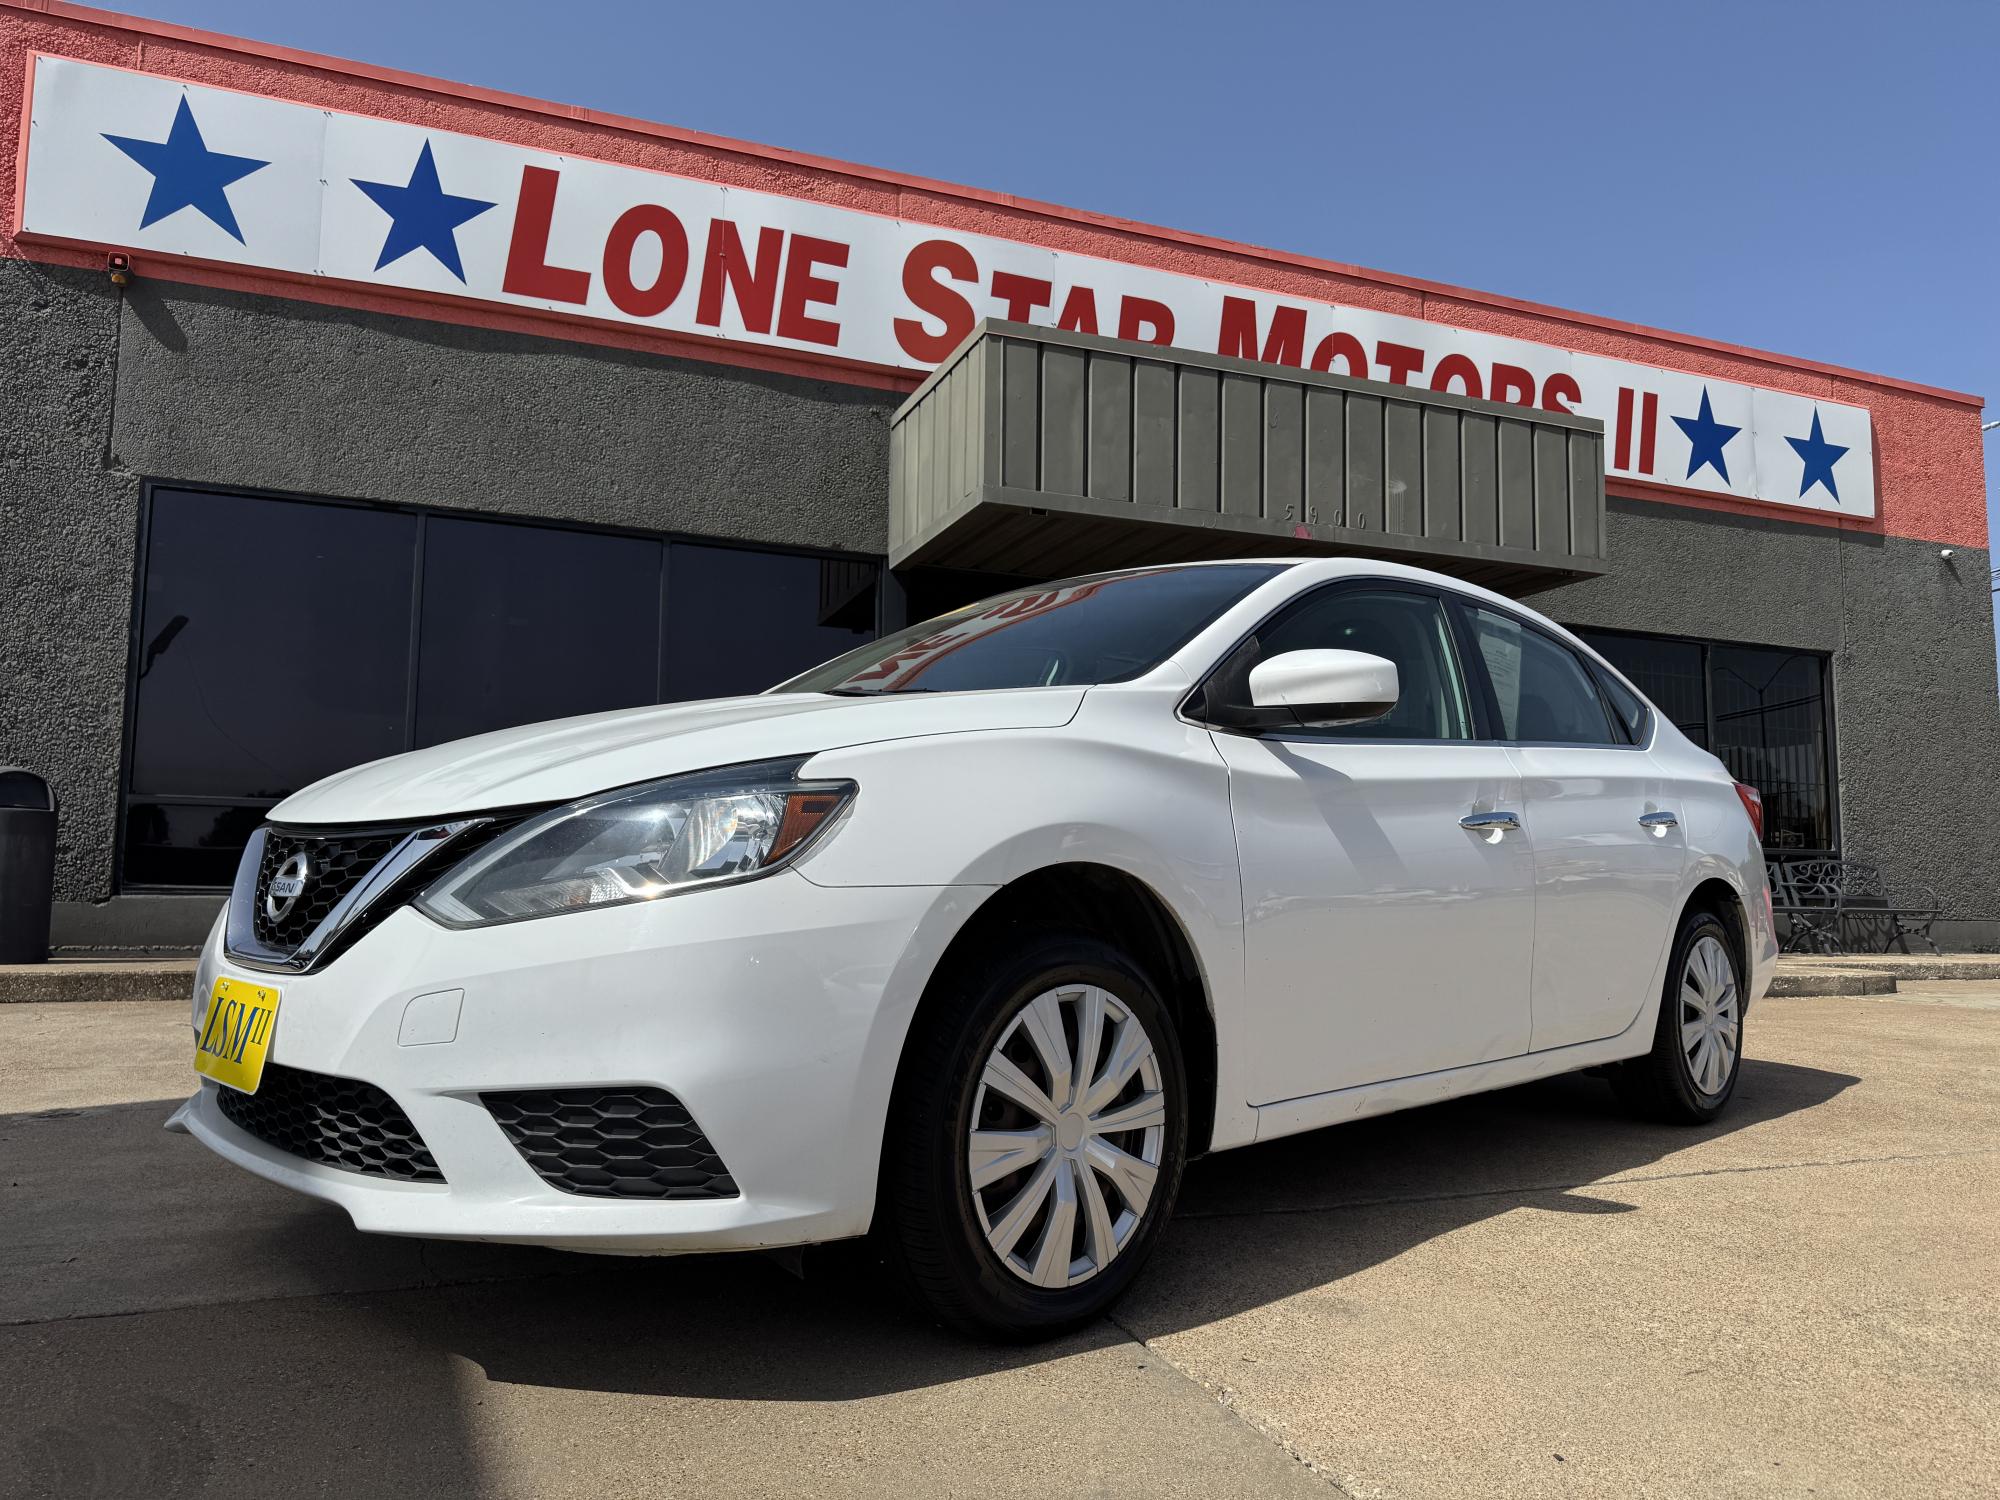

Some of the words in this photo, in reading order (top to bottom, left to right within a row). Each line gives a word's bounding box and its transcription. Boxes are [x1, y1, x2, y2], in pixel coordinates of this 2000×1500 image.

[502, 165, 850, 347] LONE
[1614, 386, 1659, 475] II
[1284, 504, 1366, 529] 5900
